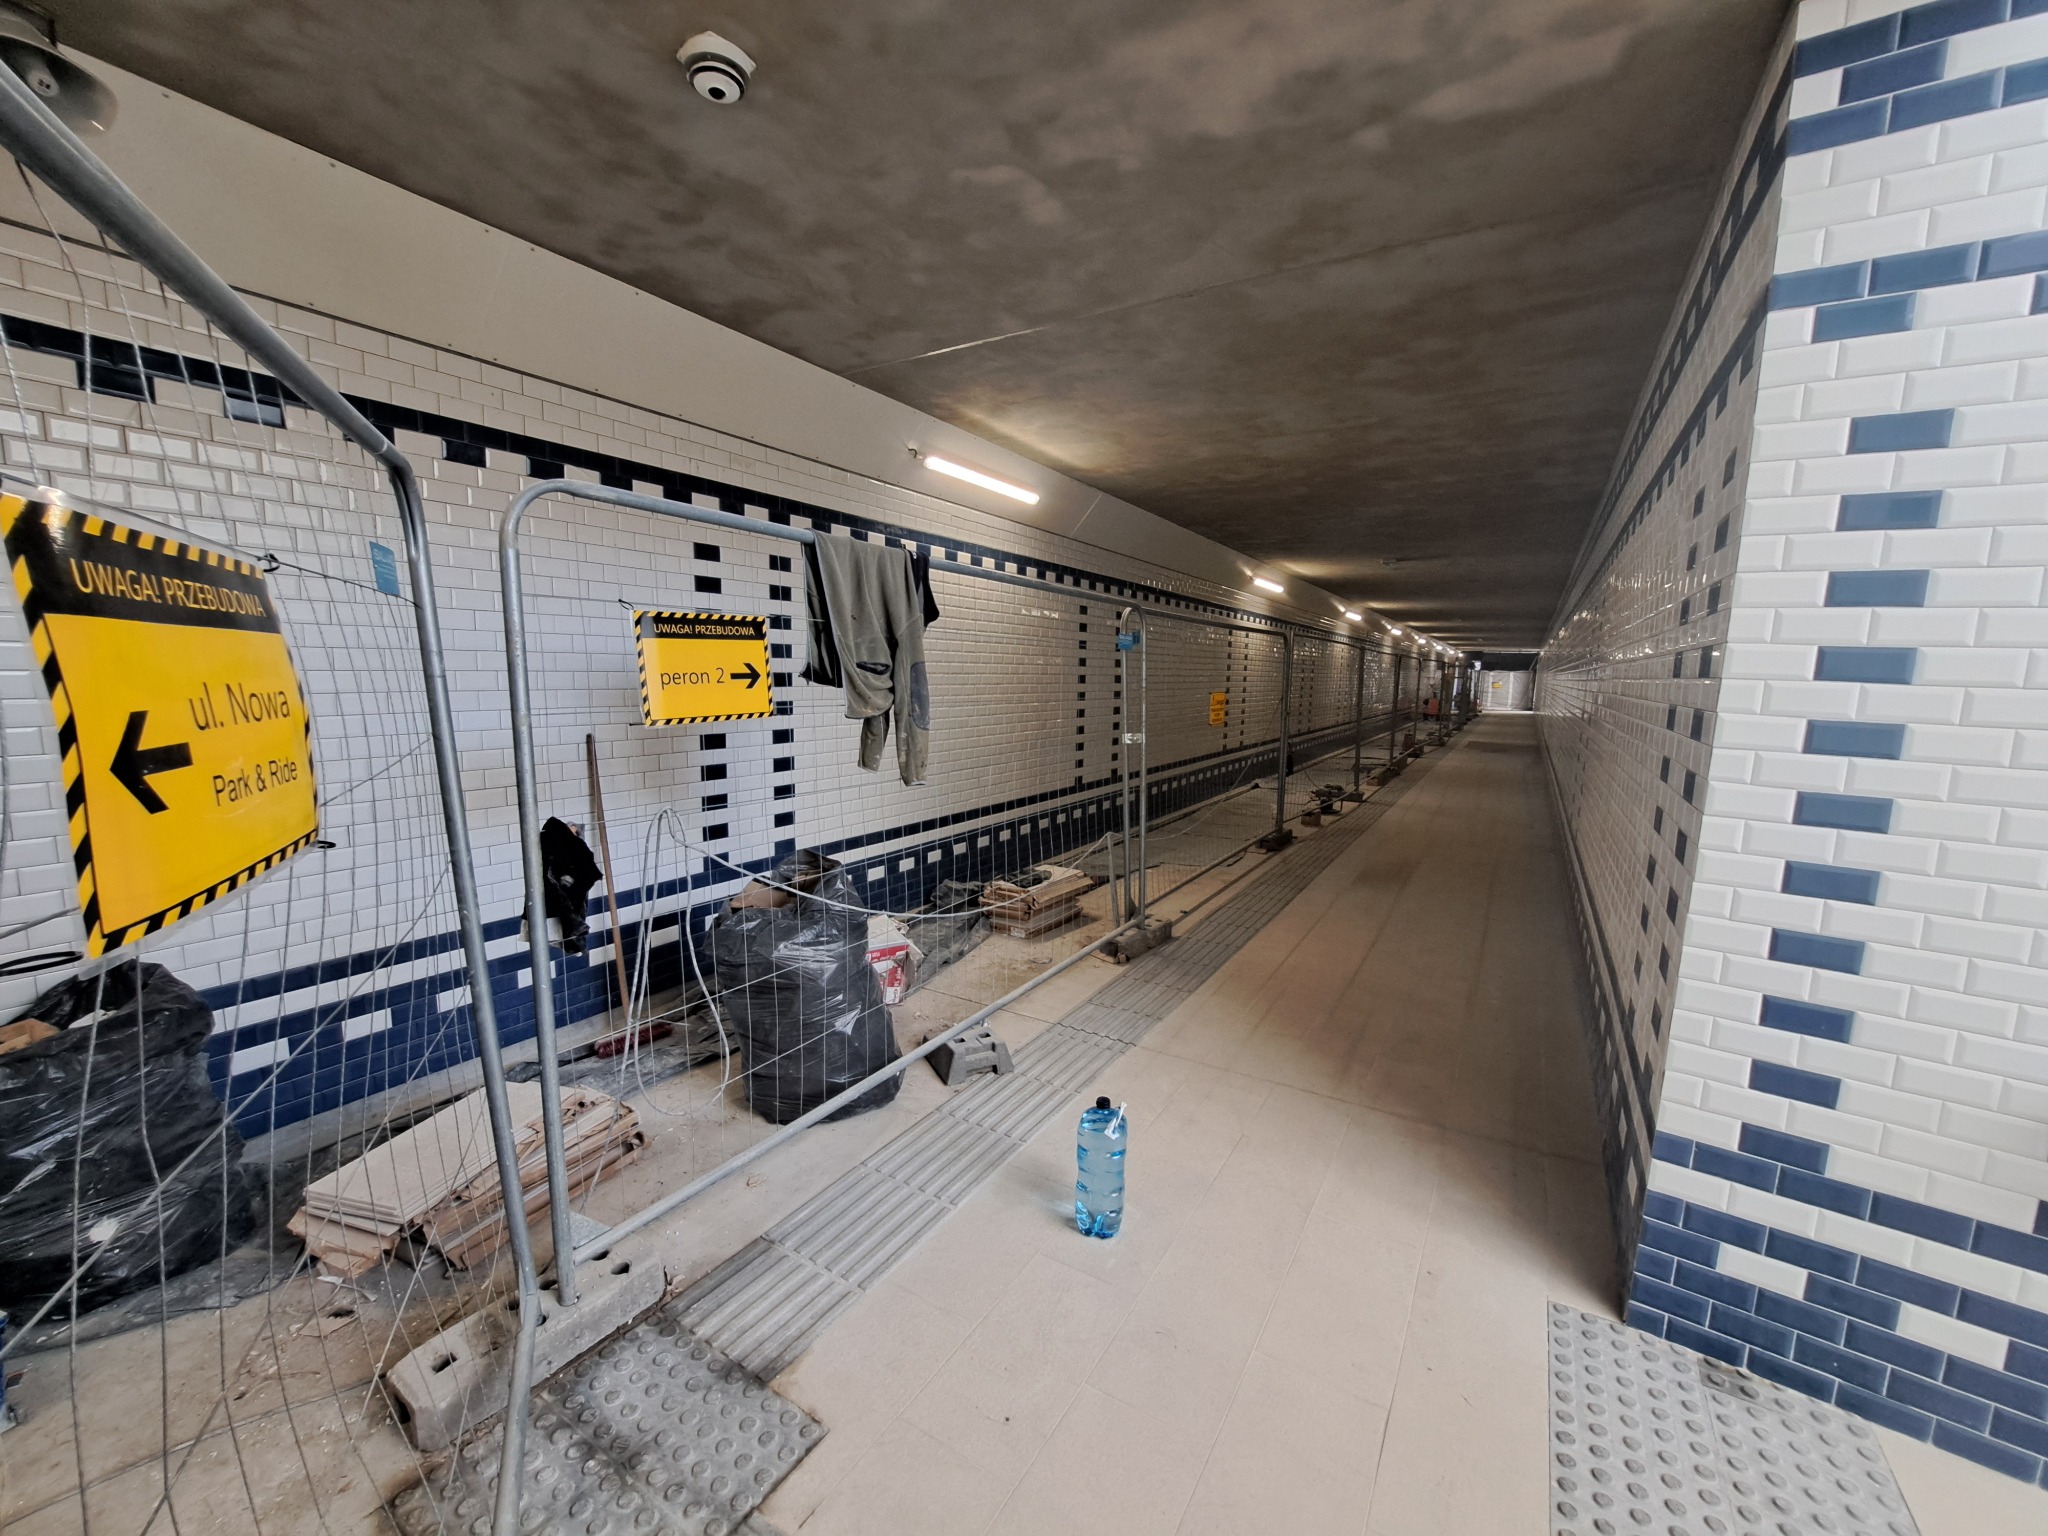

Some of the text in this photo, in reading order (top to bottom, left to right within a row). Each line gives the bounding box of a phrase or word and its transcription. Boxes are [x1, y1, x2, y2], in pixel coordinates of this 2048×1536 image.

[69, 557, 268, 618] UWAGA! PRZEBUDOWA
[653, 623, 755, 636] UWAGA! PRZEBUDOWA
[660, 667, 725, 690] peron 2
[188, 681, 291, 731] ul. Nowa
[212, 756, 298, 807] Park & Ride
